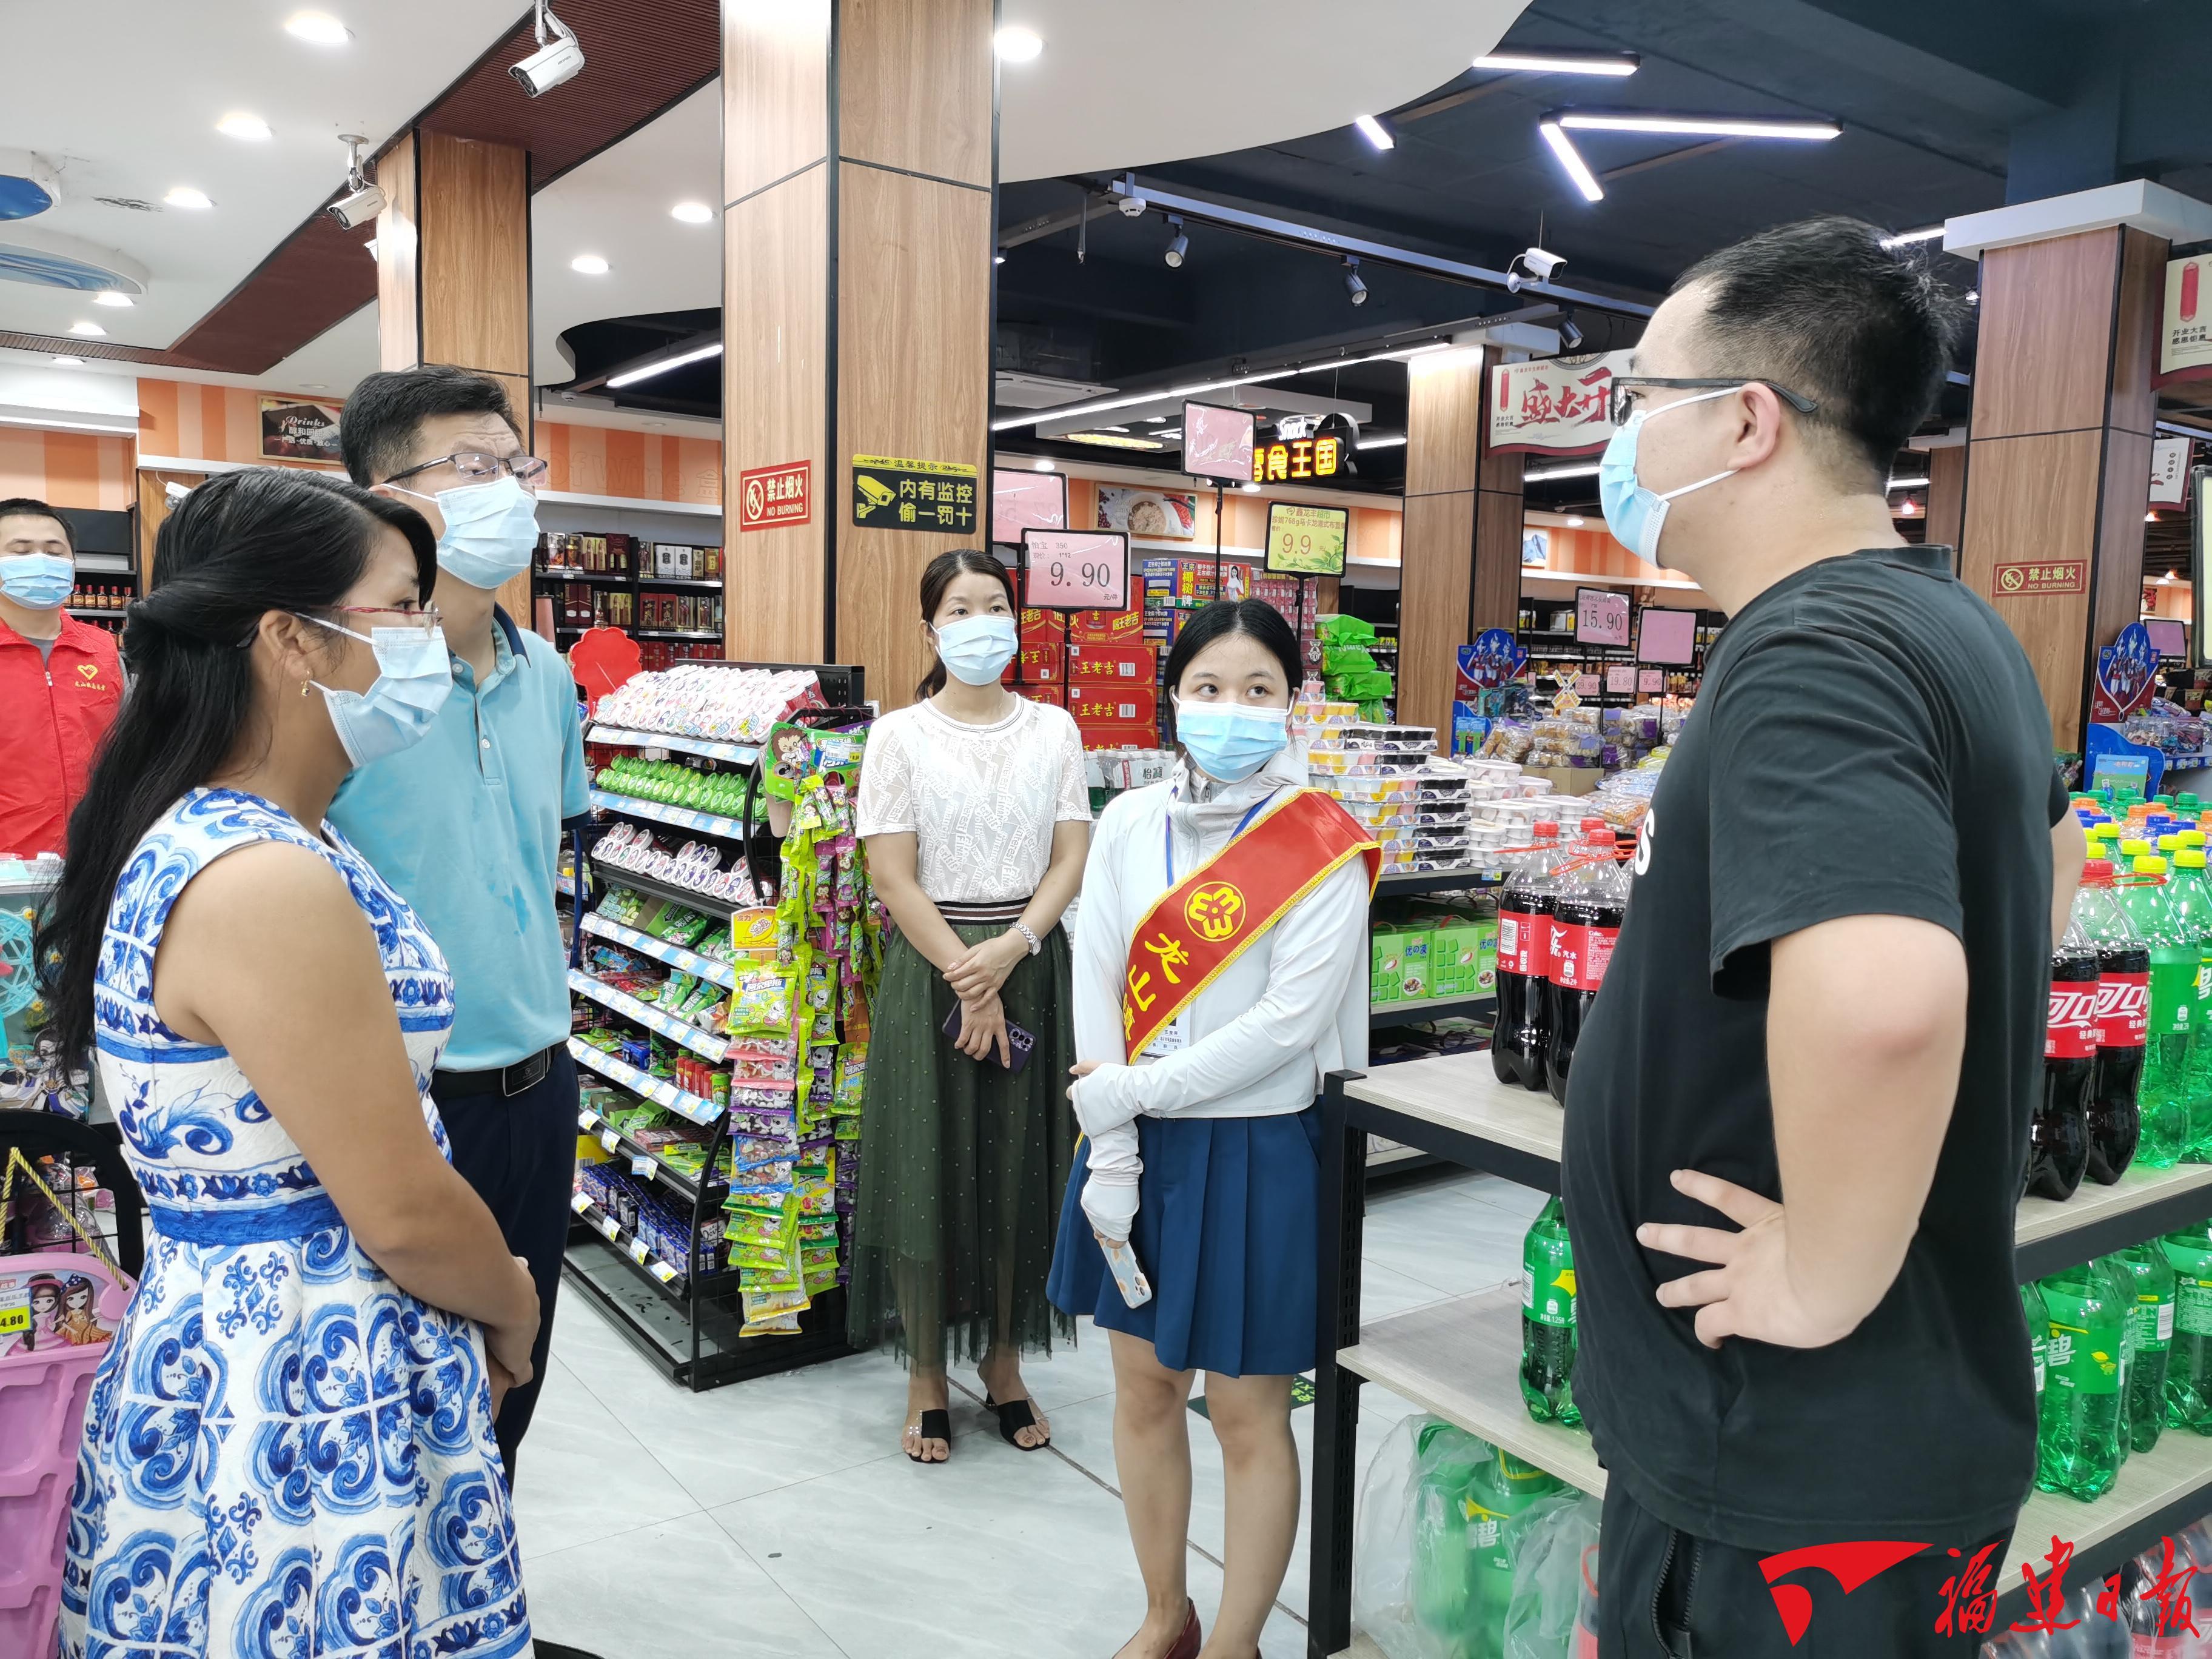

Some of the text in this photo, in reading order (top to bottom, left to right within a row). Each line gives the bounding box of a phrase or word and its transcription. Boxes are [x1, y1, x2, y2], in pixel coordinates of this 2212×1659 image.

[2172, 325, 2207, 337] 开业大吉
[286, 415, 325, 427] Drinks
[1278, 417, 1307, 441] Snack
[894, 460, 939, 471] 温馨提示
[766, 474, 803, 502] 禁止烟火
[899, 478, 973, 504] 内有监控
[766, 503, 803, 517] NO BURNING
[899, 501, 973, 527] 偷一罚十
[1031, 541, 1048, 550] 怡宝
[1282, 533, 1312, 555] 9.9
[1050, 561, 1110, 588] 9.90
[2028, 566, 2076, 581] 禁止烟火
[1181, 571, 1194, 607] 椰树牌
[1113, 611, 1139, 631] 喝王老吉
[1583, 609, 1623, 631] 15.90
[1079, 661, 1114, 675] 王老吉
[1079, 703, 1114, 717] 王老吉
[1563, 950, 1577, 959] 汽水
[745, 978, 783, 994] 阿尔卑斯
